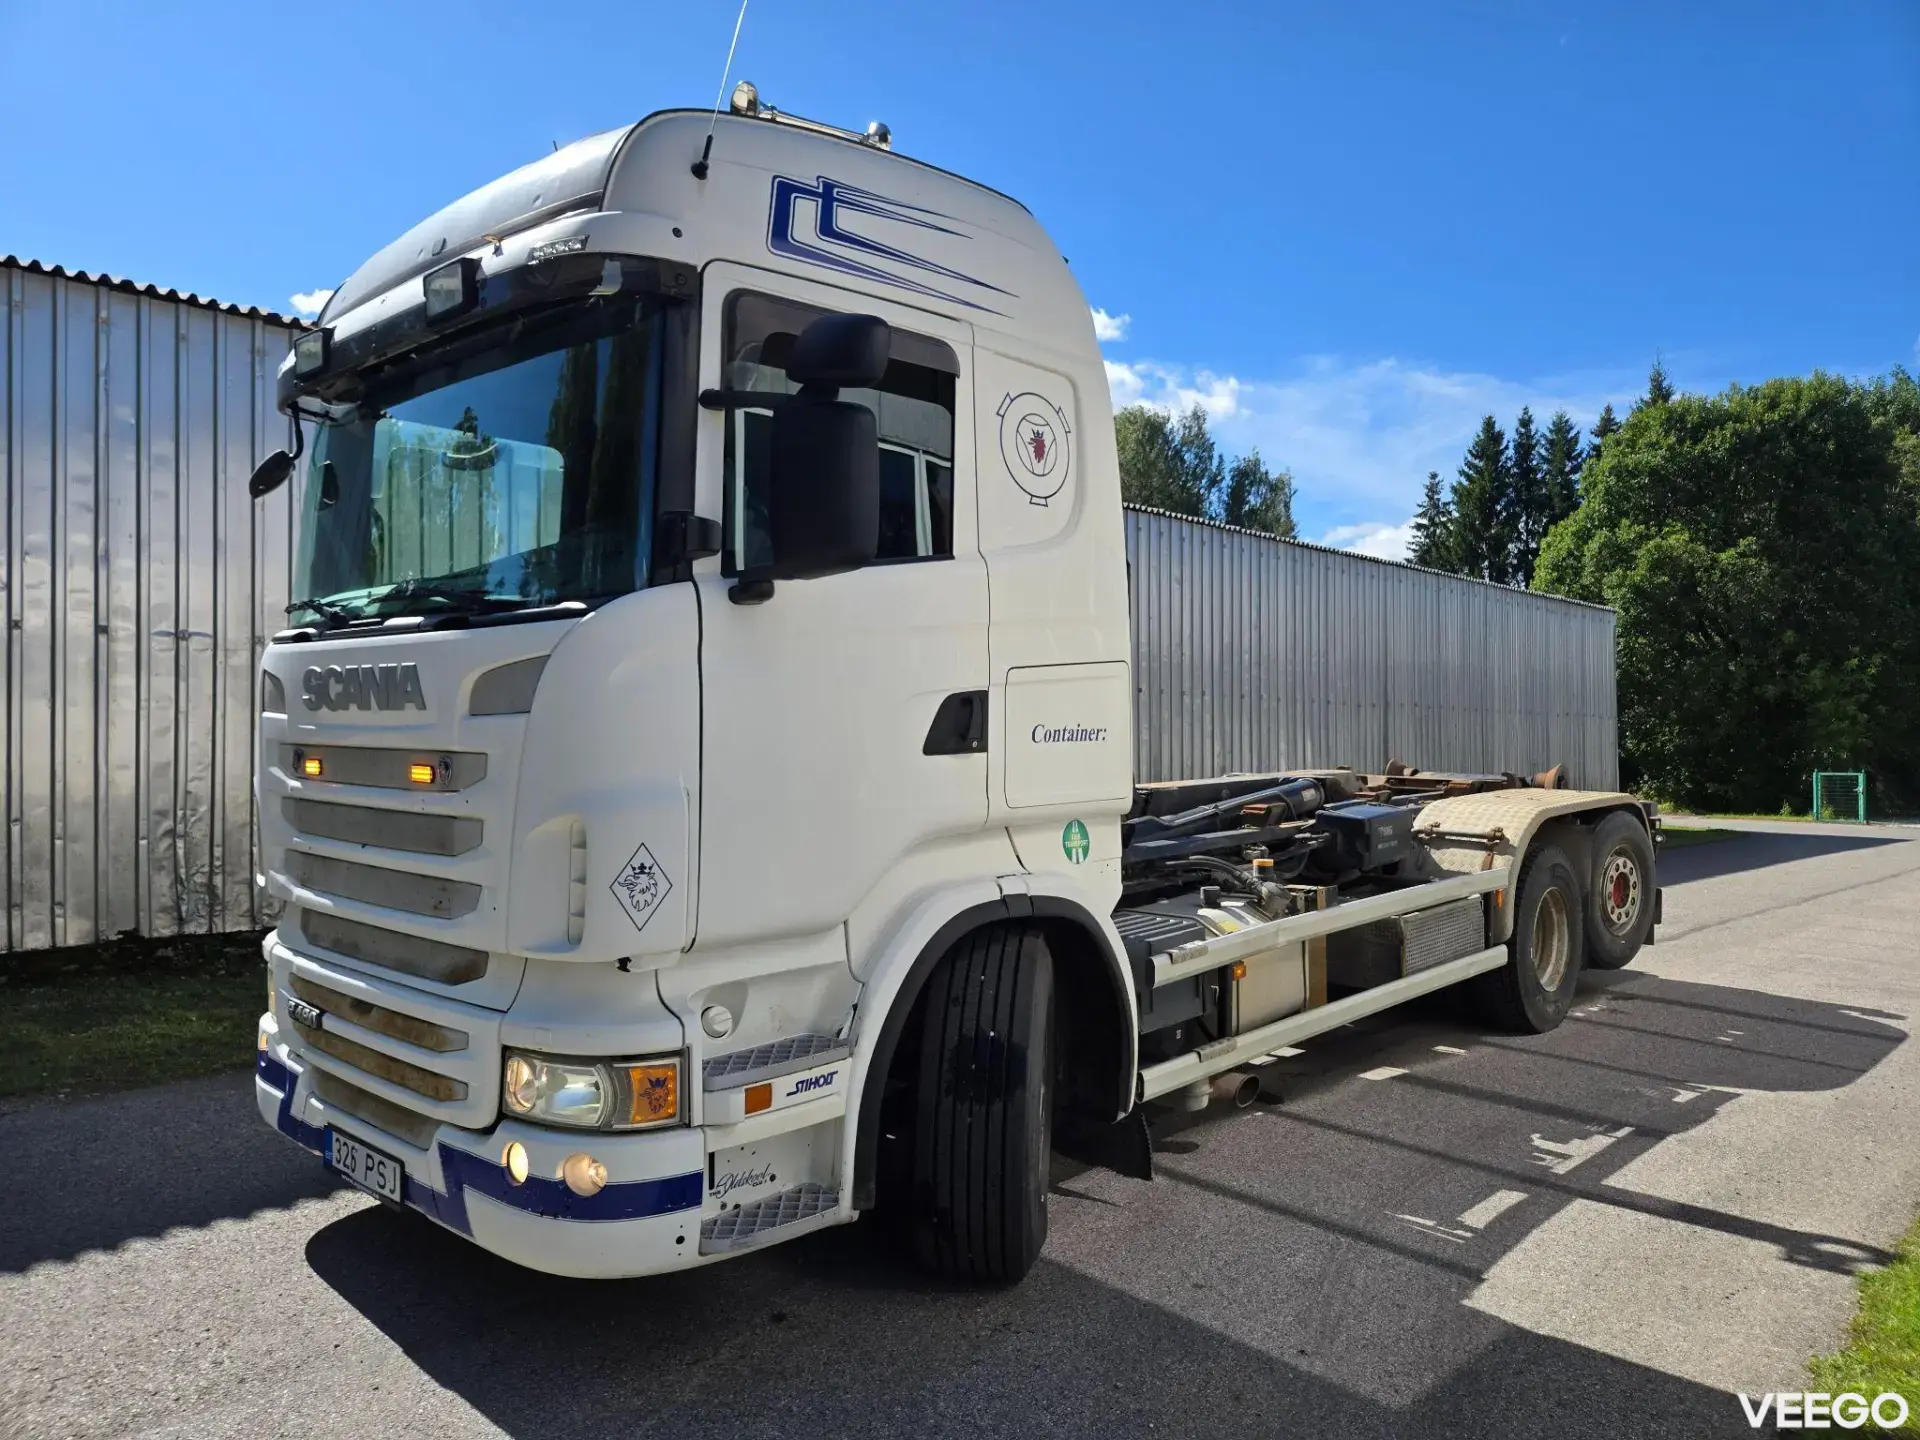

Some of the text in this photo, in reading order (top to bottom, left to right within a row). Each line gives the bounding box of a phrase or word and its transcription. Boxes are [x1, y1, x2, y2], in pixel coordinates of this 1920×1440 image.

[302, 661, 427, 712] SCANIA
[1031, 723, 1107, 744] Container:
[335, 1136, 358, 1173] 326
[364, 1153, 397, 1194] PSJ
